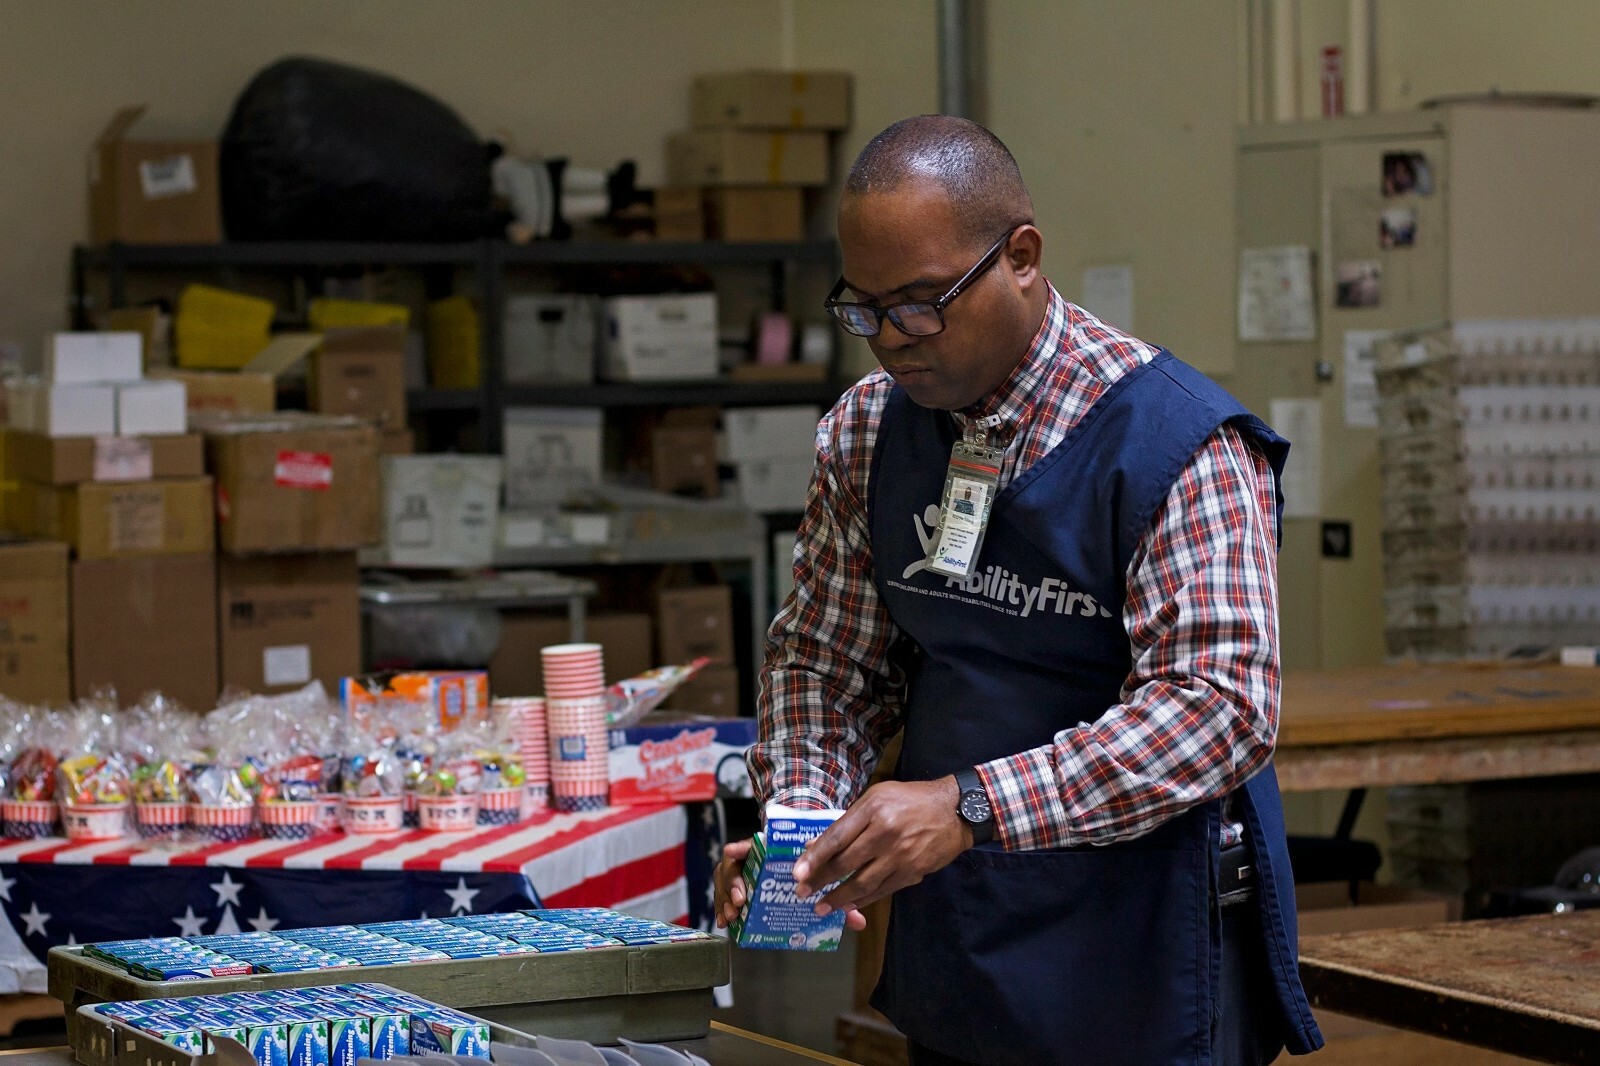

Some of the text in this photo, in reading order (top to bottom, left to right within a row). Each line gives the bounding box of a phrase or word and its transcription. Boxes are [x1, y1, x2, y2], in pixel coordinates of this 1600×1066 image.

[943, 556, 967, 568] AbilityFirst
[929, 590, 949, 599] ADULTS
[772, 831, 815, 843] Overnight
[793, 846, 801, 856] 18
[749, 934, 762, 943] 18
[346, 1029, 355, 1066] hitening
